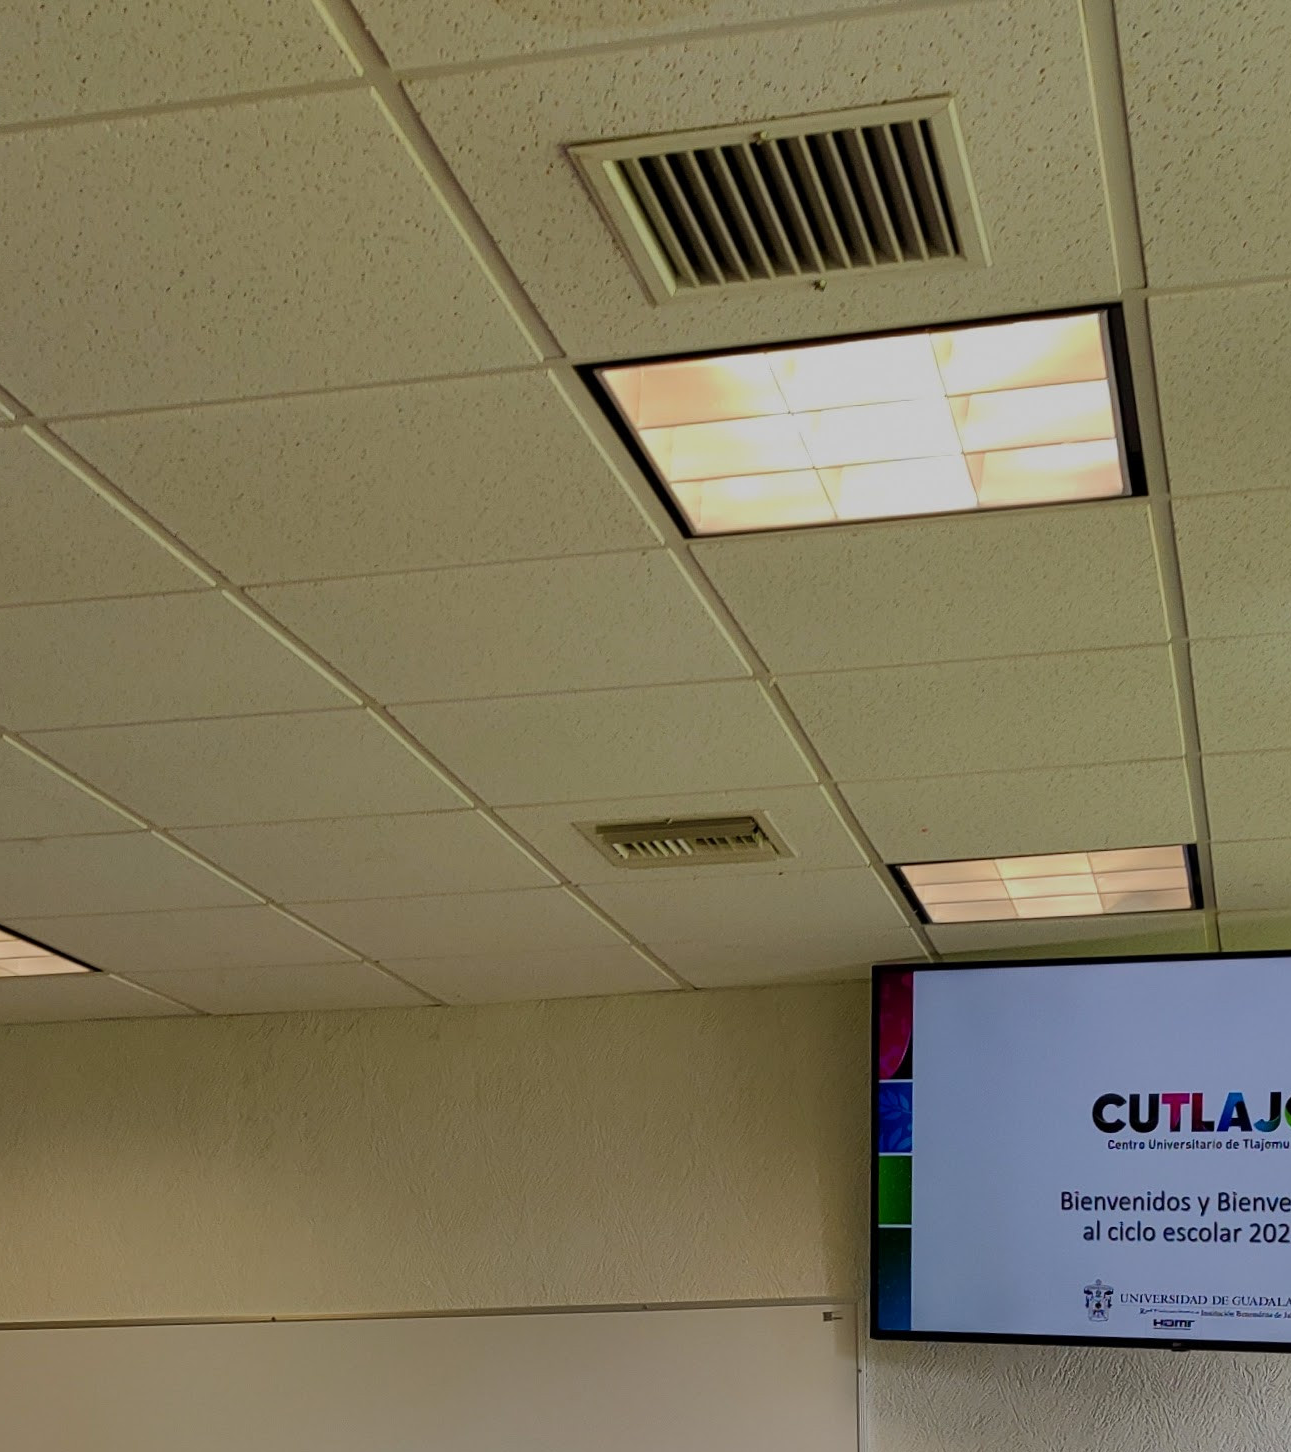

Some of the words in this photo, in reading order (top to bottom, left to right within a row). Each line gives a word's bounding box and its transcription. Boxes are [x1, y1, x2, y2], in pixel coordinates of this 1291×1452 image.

[1107, 1139, 1146, 1151] Centro
[1148, 1137, 1223, 1151] Universitario
[1225, 1138, 1240, 1151] de
[1060, 1189, 1192, 1212] Bienvenidos
[1199, 1196, 1210, 1217] y
[1082, 1220, 1101, 1242] al
[1107, 1220, 1157, 1243] ciclo
[1162, 1221, 1243, 1244] escolar
[1120, 1293, 1208, 1306] UNIVERSIDAD
[1212, 1295, 1229, 1306] DE
